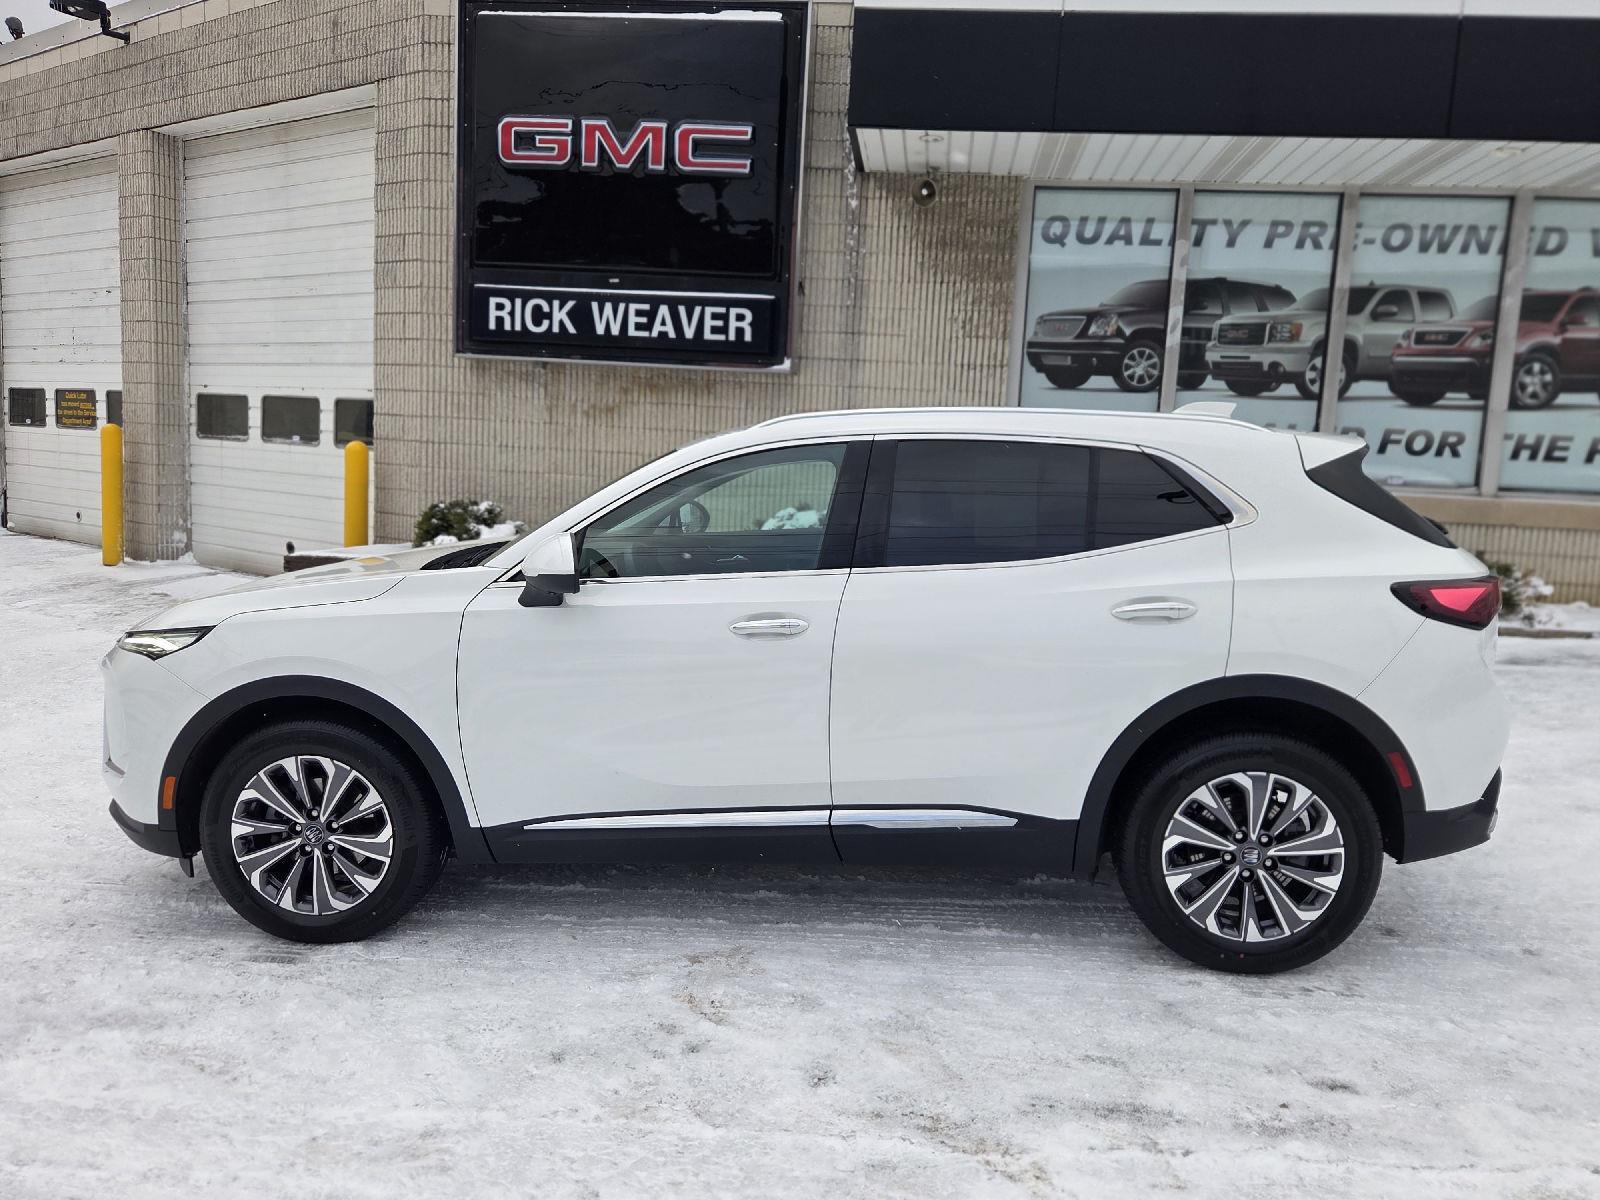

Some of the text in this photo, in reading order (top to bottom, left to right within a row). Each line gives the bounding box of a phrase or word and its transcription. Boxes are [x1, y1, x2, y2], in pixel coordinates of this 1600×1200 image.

[498, 116, 754, 174] GMC
[488, 296, 753, 342] RICK WEAVER
[1376, 427, 1466, 458] FOR
